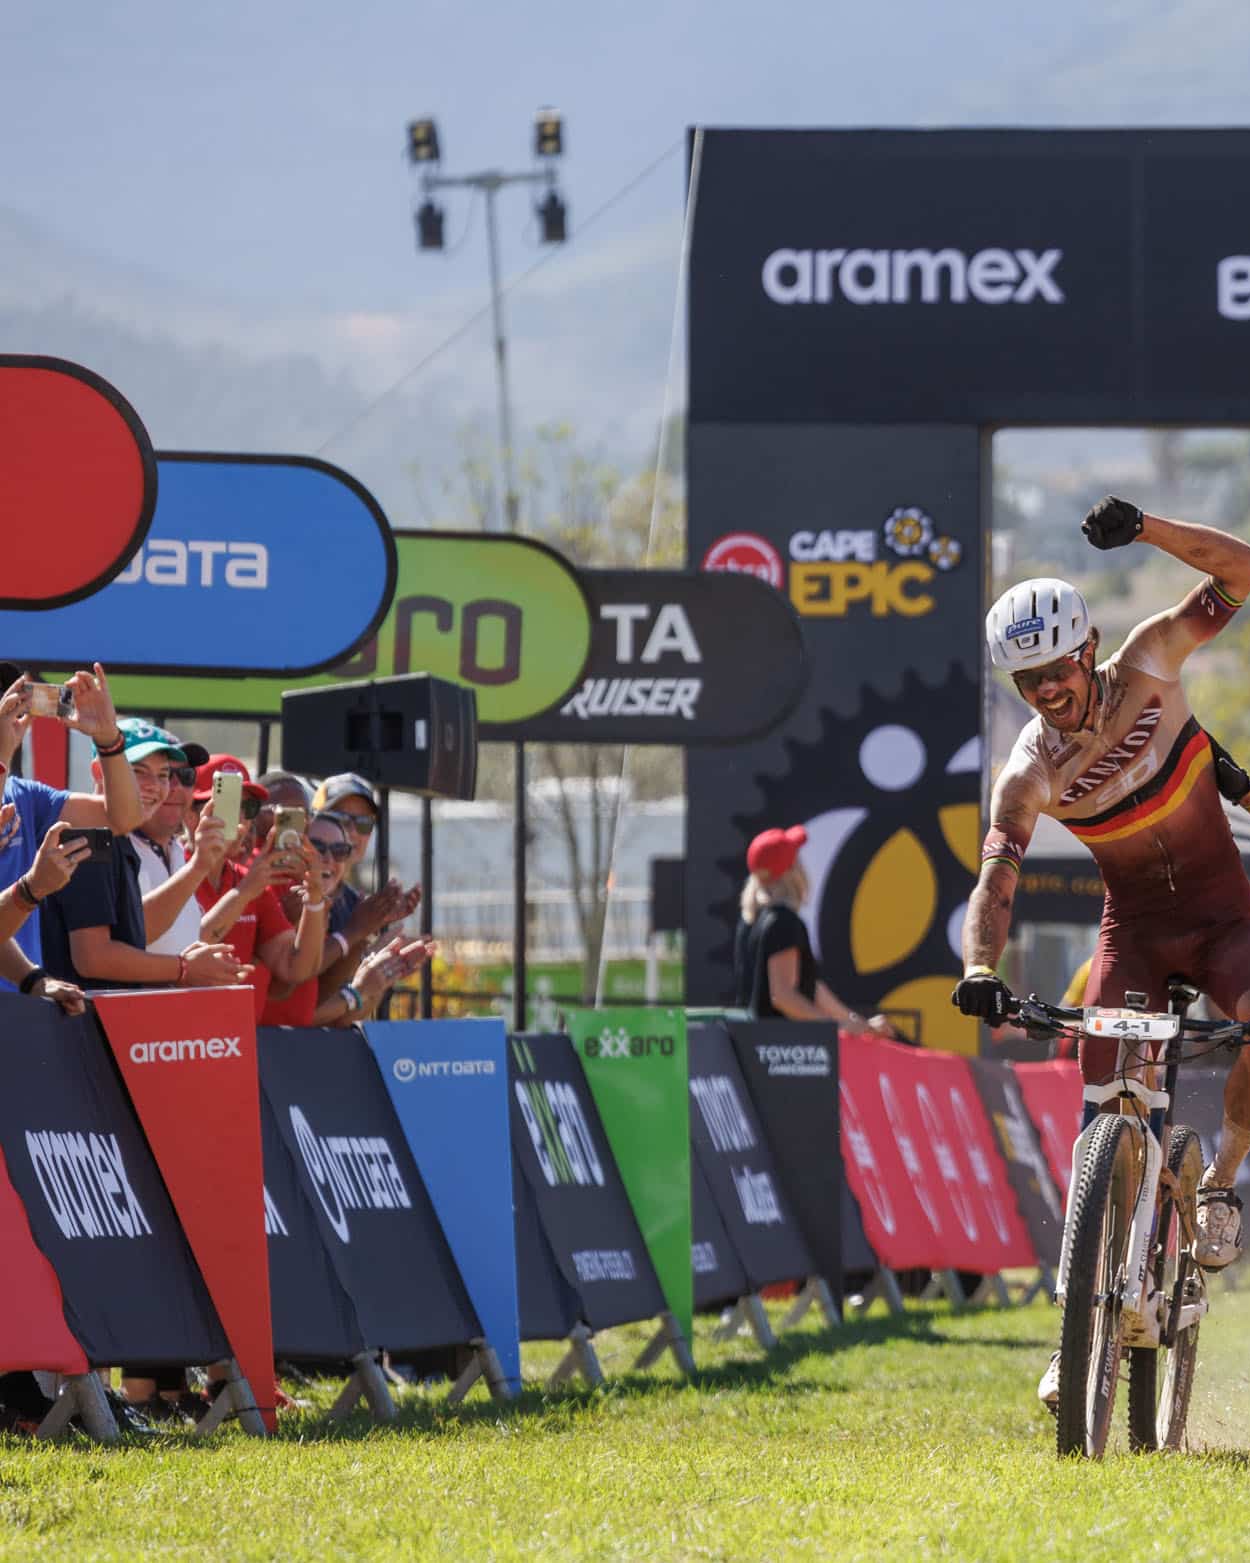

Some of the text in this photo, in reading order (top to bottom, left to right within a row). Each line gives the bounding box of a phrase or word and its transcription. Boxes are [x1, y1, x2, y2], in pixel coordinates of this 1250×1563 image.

[762, 248, 1064, 304] aramex
[788, 530, 877, 562] CAPE
[788, 561, 934, 617] EPIC
[600, 604, 702, 664] TA
[1059, 707, 1162, 803] CANYON
[1112, 1020, 1152, 1034] 4-1
[130, 1036, 242, 1064] aramex
[584, 1028, 675, 1059] exxaro
[756, 1045, 828, 1064] TOYOTA
[419, 1061, 450, 1076] NTT
